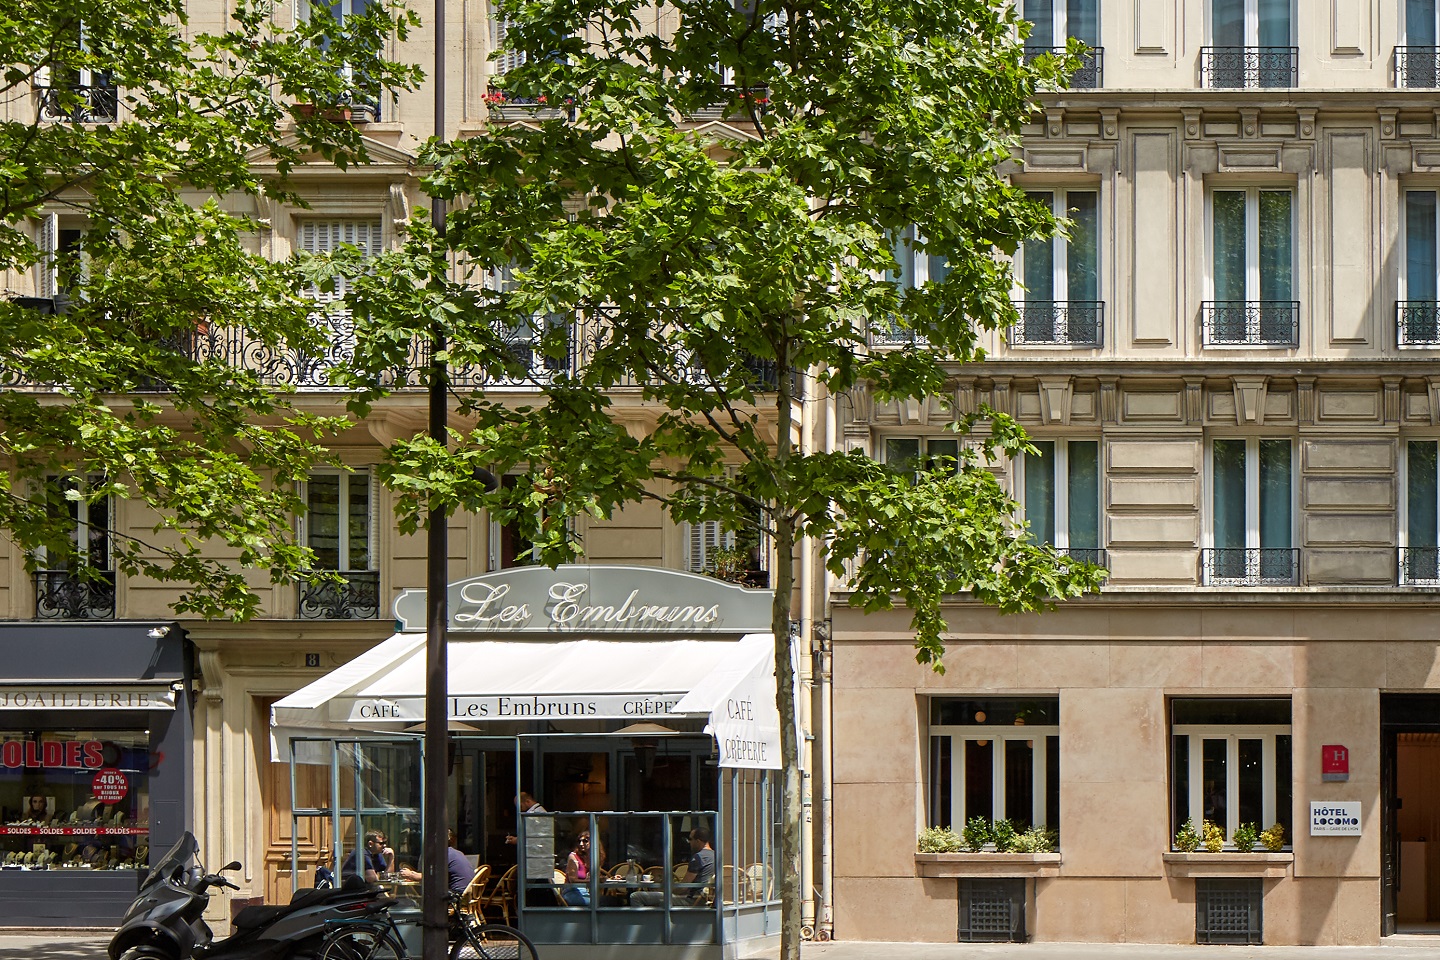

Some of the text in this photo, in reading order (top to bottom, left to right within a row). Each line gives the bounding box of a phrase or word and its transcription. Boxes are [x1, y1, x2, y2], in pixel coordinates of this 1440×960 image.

[454, 582, 720, 626] Les Embruns
[308, 654, 317, 666] 8
[2, 693, 150, 707] JOAILLERIE
[452, 696, 678, 717] Les Embruns CRÊPE
[360, 701, 400, 718] CAFÉ
[727, 695, 754, 721] CAFÉ
[725, 735, 767, 763] CRÊPERIE
[1333, 750, 1345, 761] H
[95, 775, 125, 784] -40%
[1313, 806, 1348, 816] HÔTEL
[1313, 817, 1359, 826] LOCOMO
